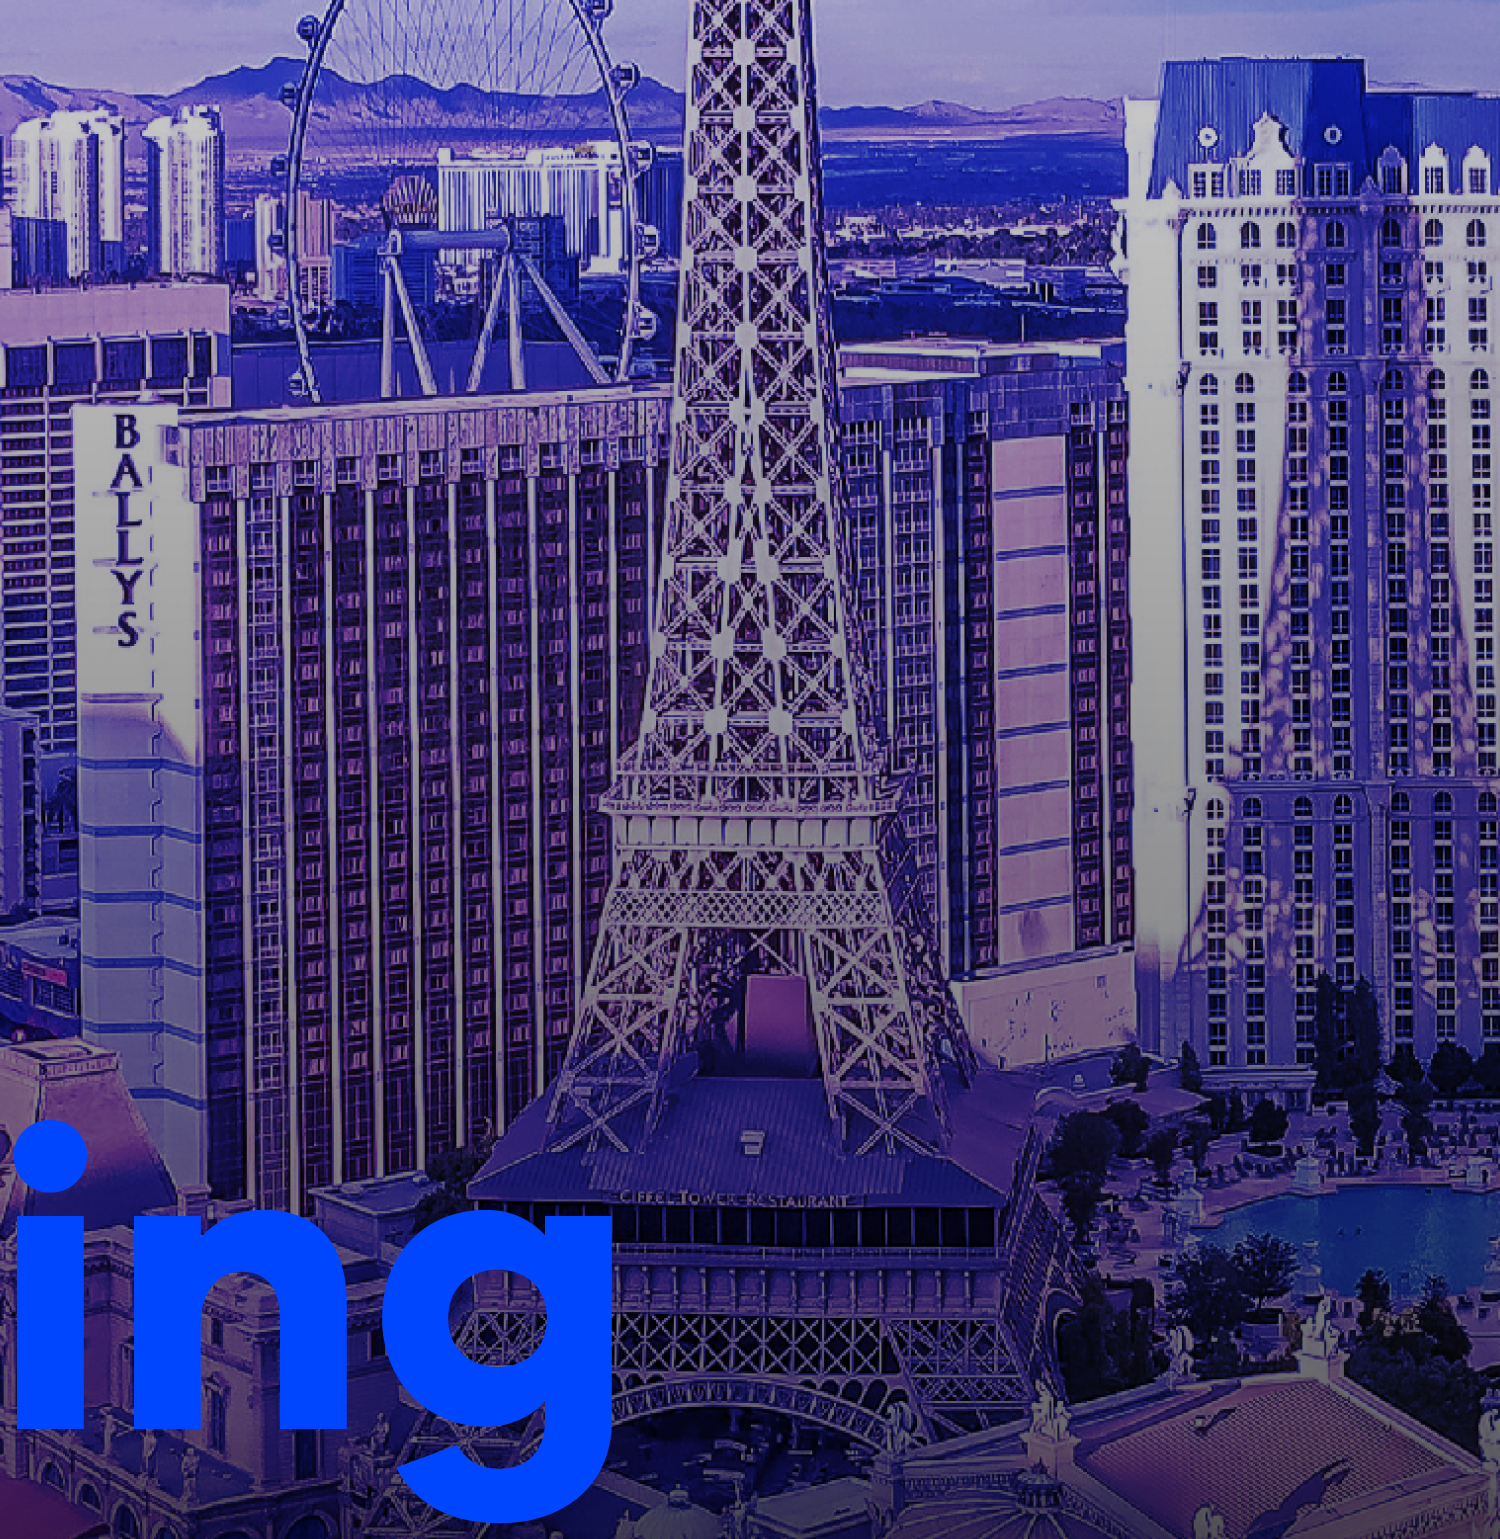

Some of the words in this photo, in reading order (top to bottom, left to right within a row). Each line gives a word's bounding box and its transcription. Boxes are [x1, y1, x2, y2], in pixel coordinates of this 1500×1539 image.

[111, 414, 144, 647] BALLYS
[679, 1189, 736, 1207] TOWER
[746, 1192, 850, 1210] RESTAURANT
